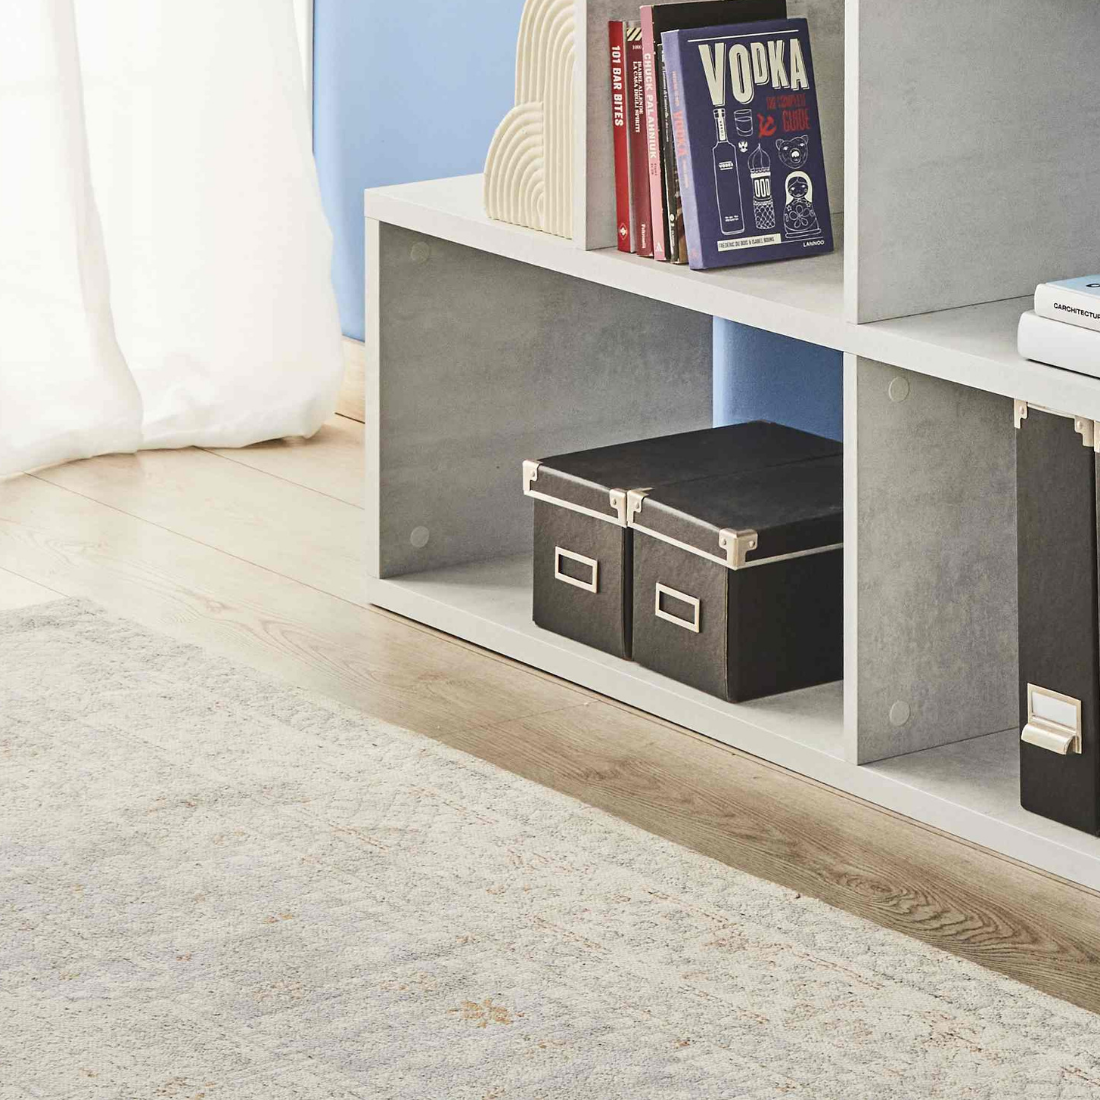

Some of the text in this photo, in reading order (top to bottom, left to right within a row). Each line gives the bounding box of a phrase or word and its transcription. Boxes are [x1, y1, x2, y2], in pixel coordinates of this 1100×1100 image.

[611, 45, 624, 127] 101 BAR BITES
[644, 52, 653, 91] CHUCK
[697, 38, 811, 107] VODKA
[646, 94, 657, 159] PALAHNIUK
[672, 109, 689, 157] VODKA
[803, 239, 825, 248] LANNOO
